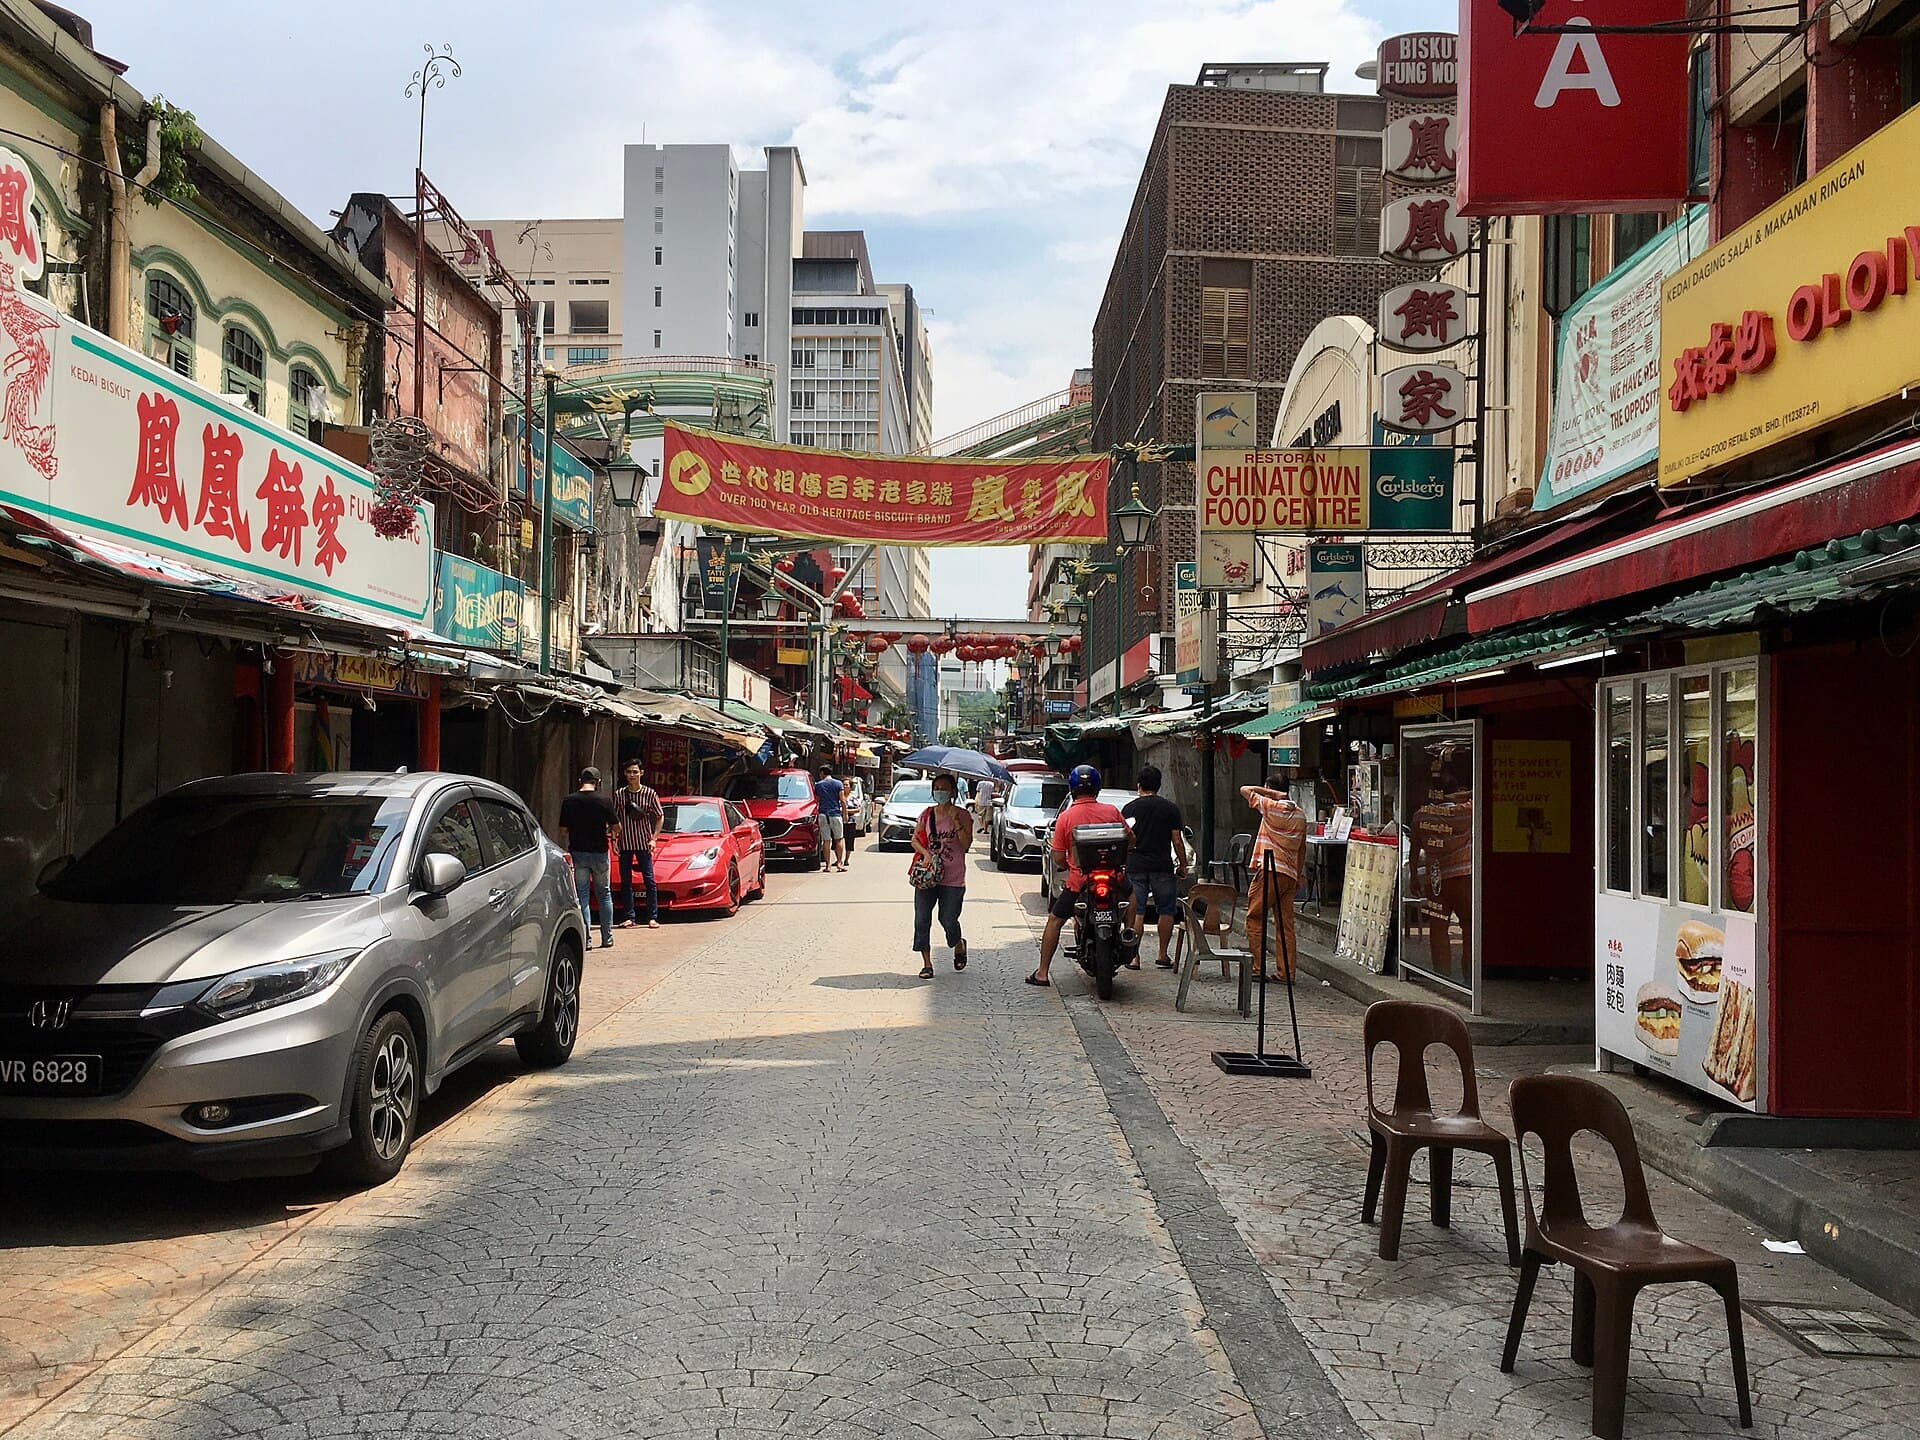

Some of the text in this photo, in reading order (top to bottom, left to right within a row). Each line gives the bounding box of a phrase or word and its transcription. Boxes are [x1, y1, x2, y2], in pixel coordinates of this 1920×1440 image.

[1385, 61, 1427, 84] FUNG
[1534, 16, 1621, 107] A
[1666, 159, 1865, 303] KEDAI DAGING SALAI & MAKANAN RINGAN
[71, 365, 132, 401] KEDAI BISKUT
[1610, 359, 1660, 404] WE HAVE REL
[1610, 411, 1624, 431] THE
[1624, 387, 1660, 421] OPPOSIT
[1711, 440, 1728, 457] FOOD
[1728, 432, 1749, 449] RETAIL
[1765, 417, 1781, 433] BHD.
[1244, 453, 1326, 464] RESTORAN
[127, 391, 347, 578] 鳳凰餅家
[1207, 465, 1360, 496] CHINATOWN
[1376, 475, 1445, 502] Carlsberg
[719, 491, 951, 524] OVER 100 YEAR OLD HERITAGE BISCUIT BRAND
[1205, 497, 1361, 526] FOOD CENTRE
[1316, 550, 1355, 566] Carlsberg
[1180, 569, 1196, 582] Carl
[1178, 592, 1217, 607] RESTON
[1520, 758, 1561, 768] SWEET
[1504, 782, 1528, 791] THE
[32, 1060, 87, 1083] 6828
